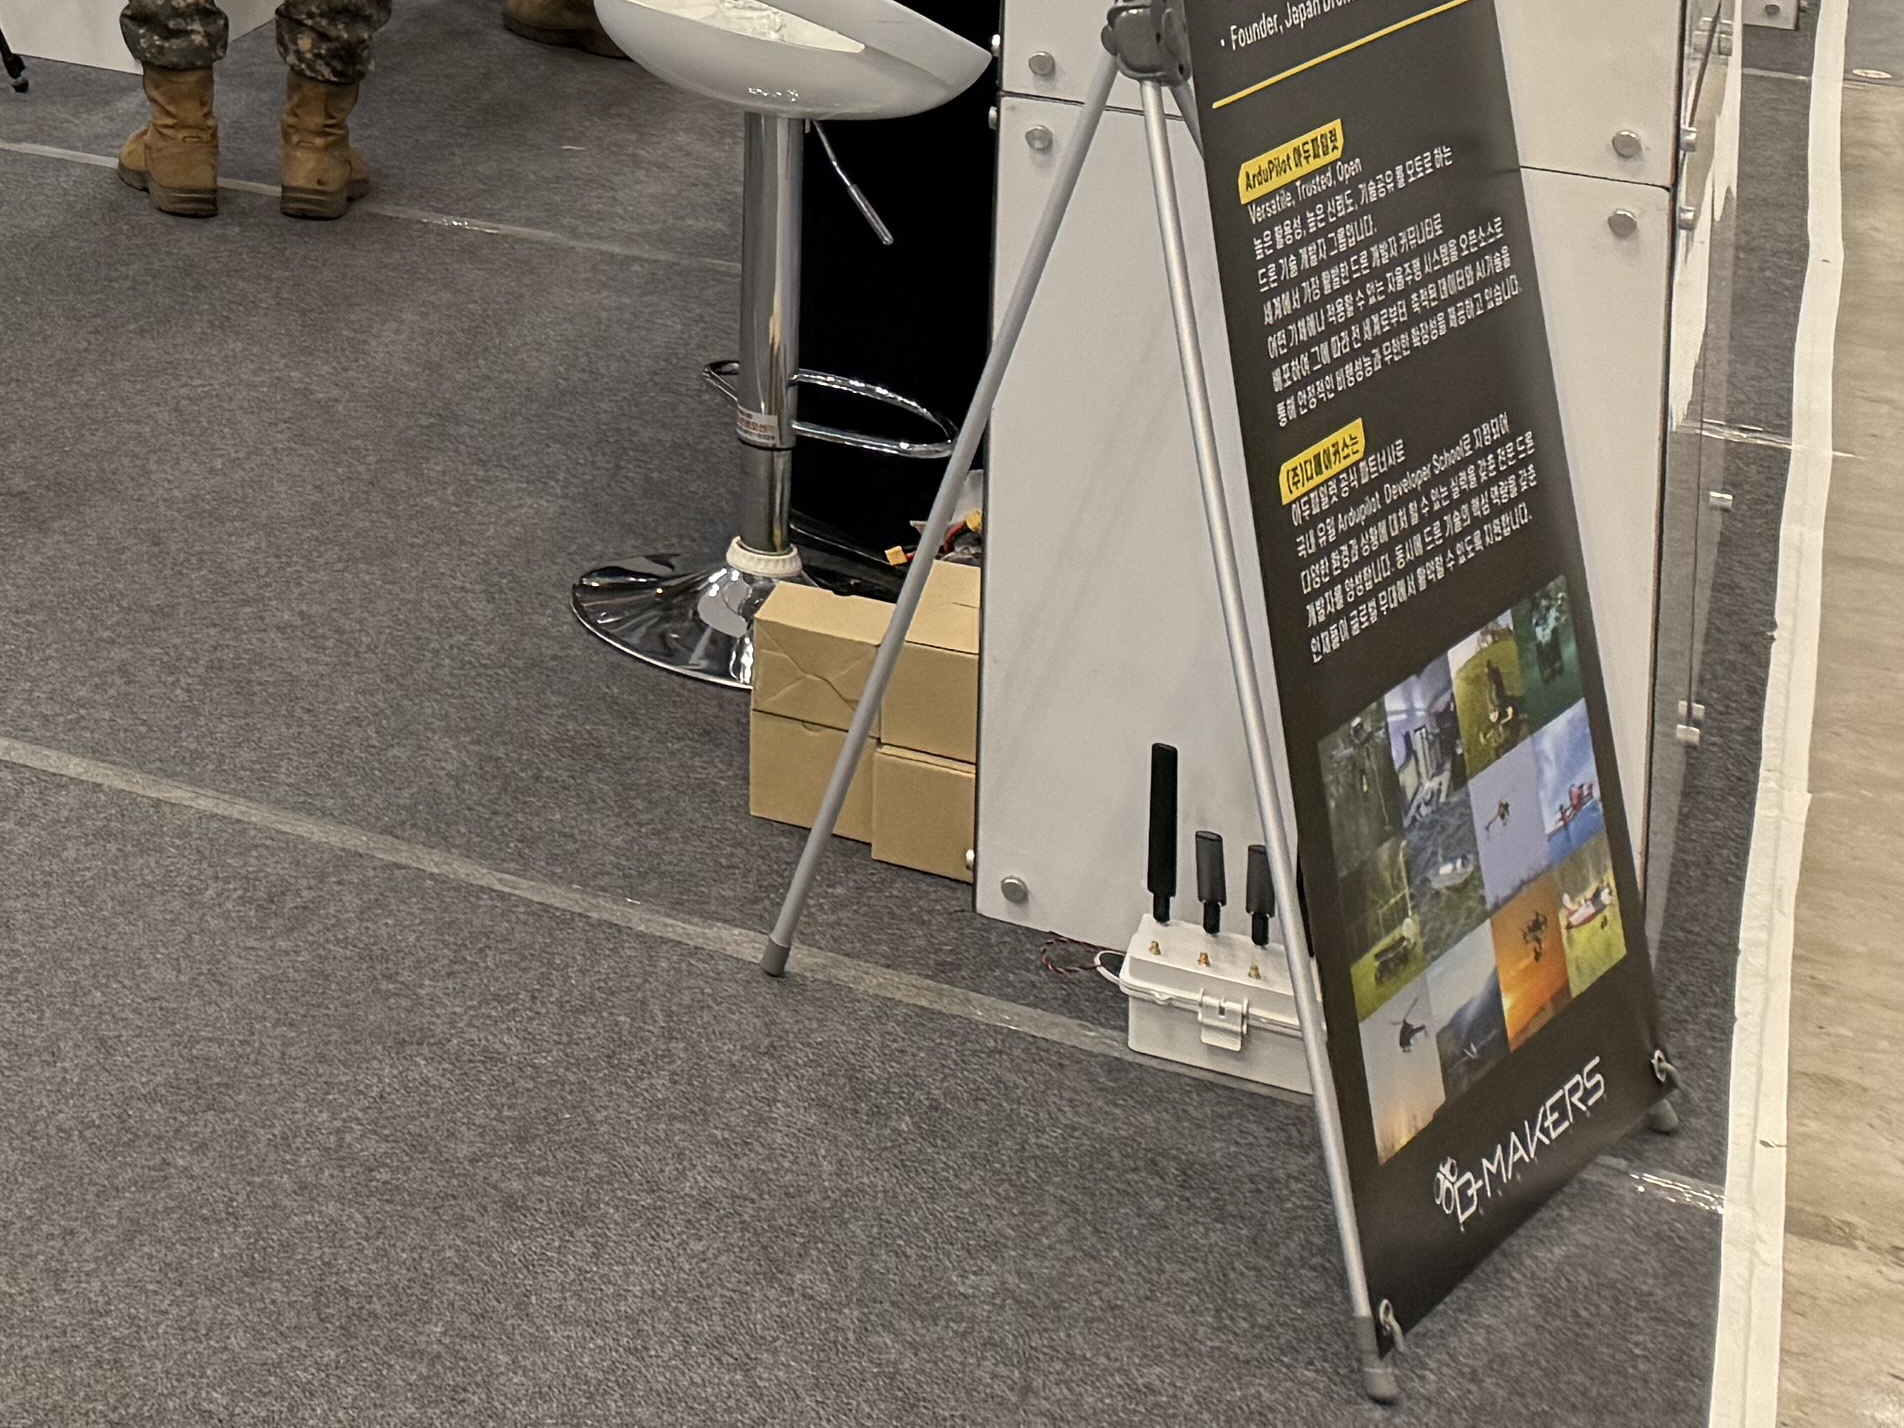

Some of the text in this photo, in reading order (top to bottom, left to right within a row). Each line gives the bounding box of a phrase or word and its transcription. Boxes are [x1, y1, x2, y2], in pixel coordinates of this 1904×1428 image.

[1229, 12, 1283, 50] Founder,
[1244, 127, 1338, 191] ArduPilot 아두파일럿
[1335, 157, 1362, 184] Open
[1452, 1055, 1607, 1224] D-MAKERS
